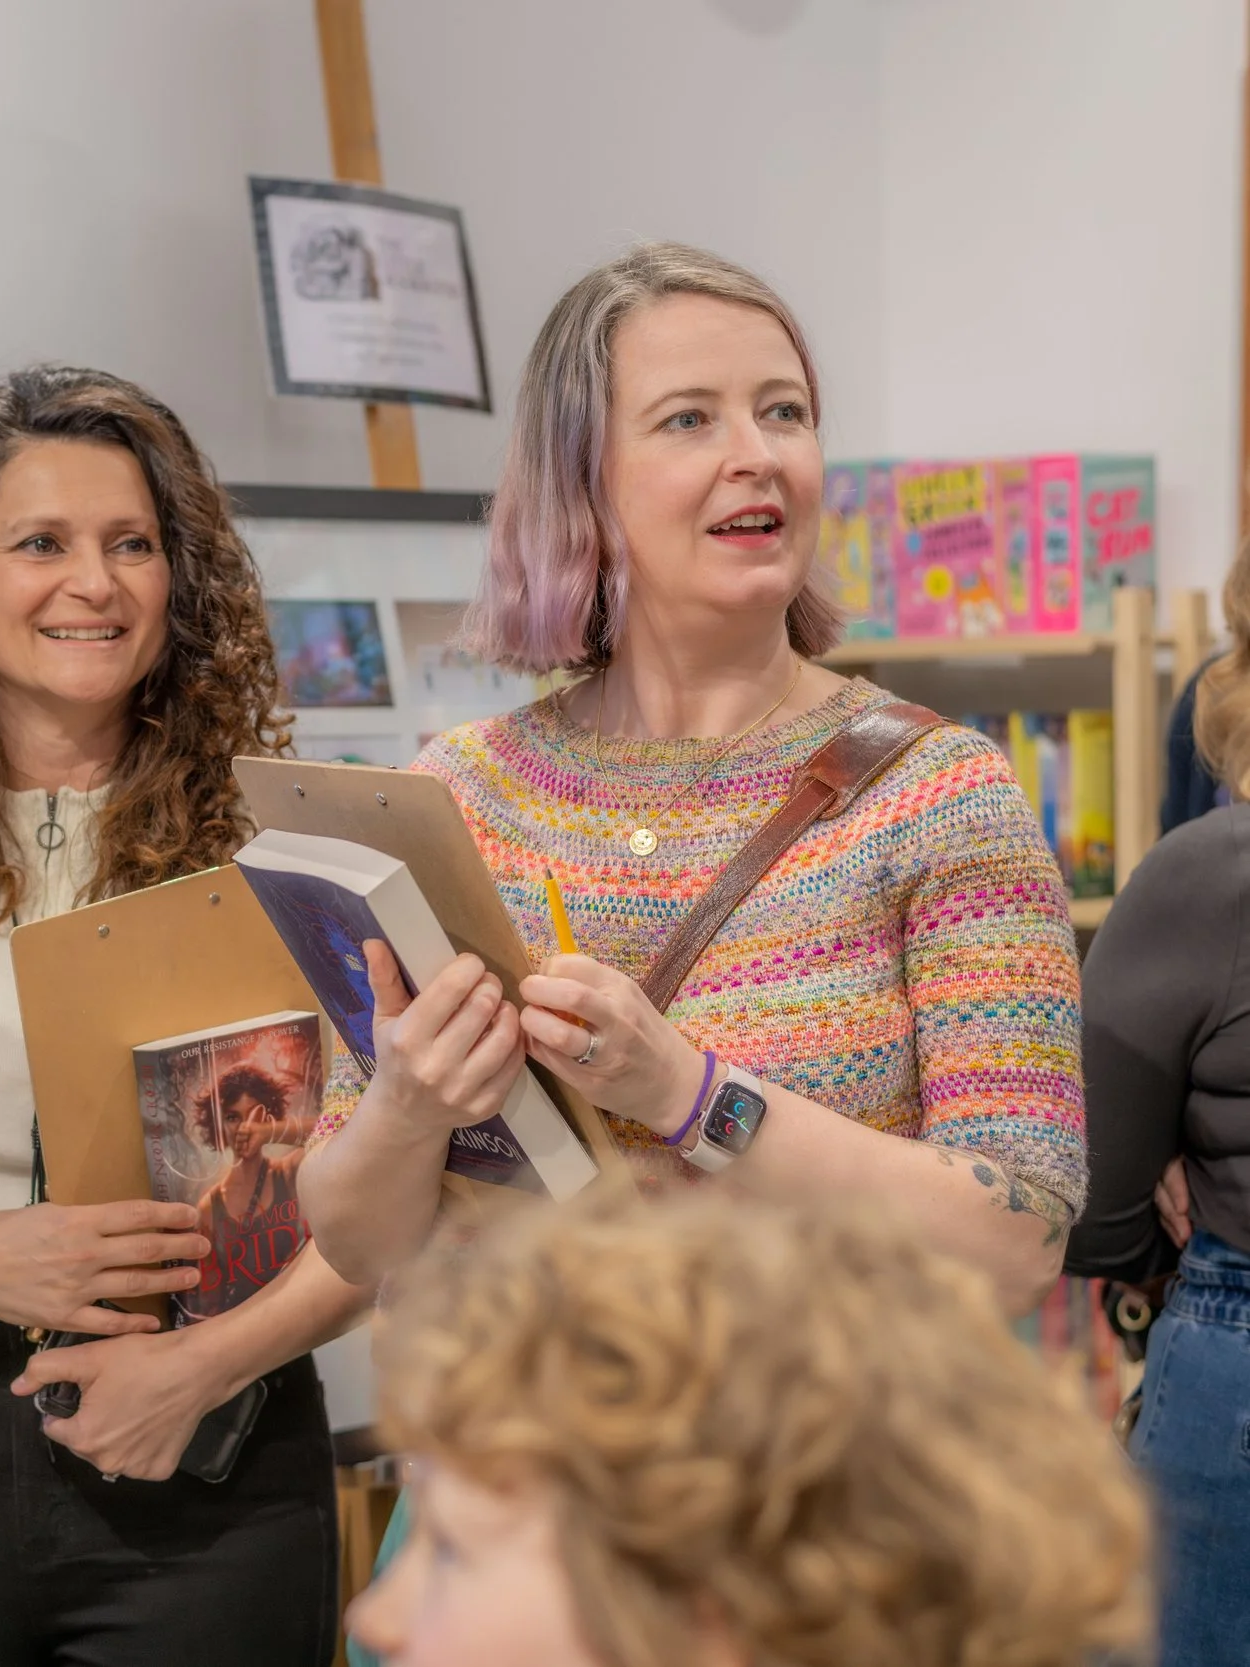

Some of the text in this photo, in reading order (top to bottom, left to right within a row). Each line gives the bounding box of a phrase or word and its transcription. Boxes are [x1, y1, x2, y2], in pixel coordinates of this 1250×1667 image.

[181, 1025, 300, 1059] OUR RESISTANCE IS POWER
[451, 1127, 526, 1165] LKINSON
[261, 1198, 300, 1229] MOO
